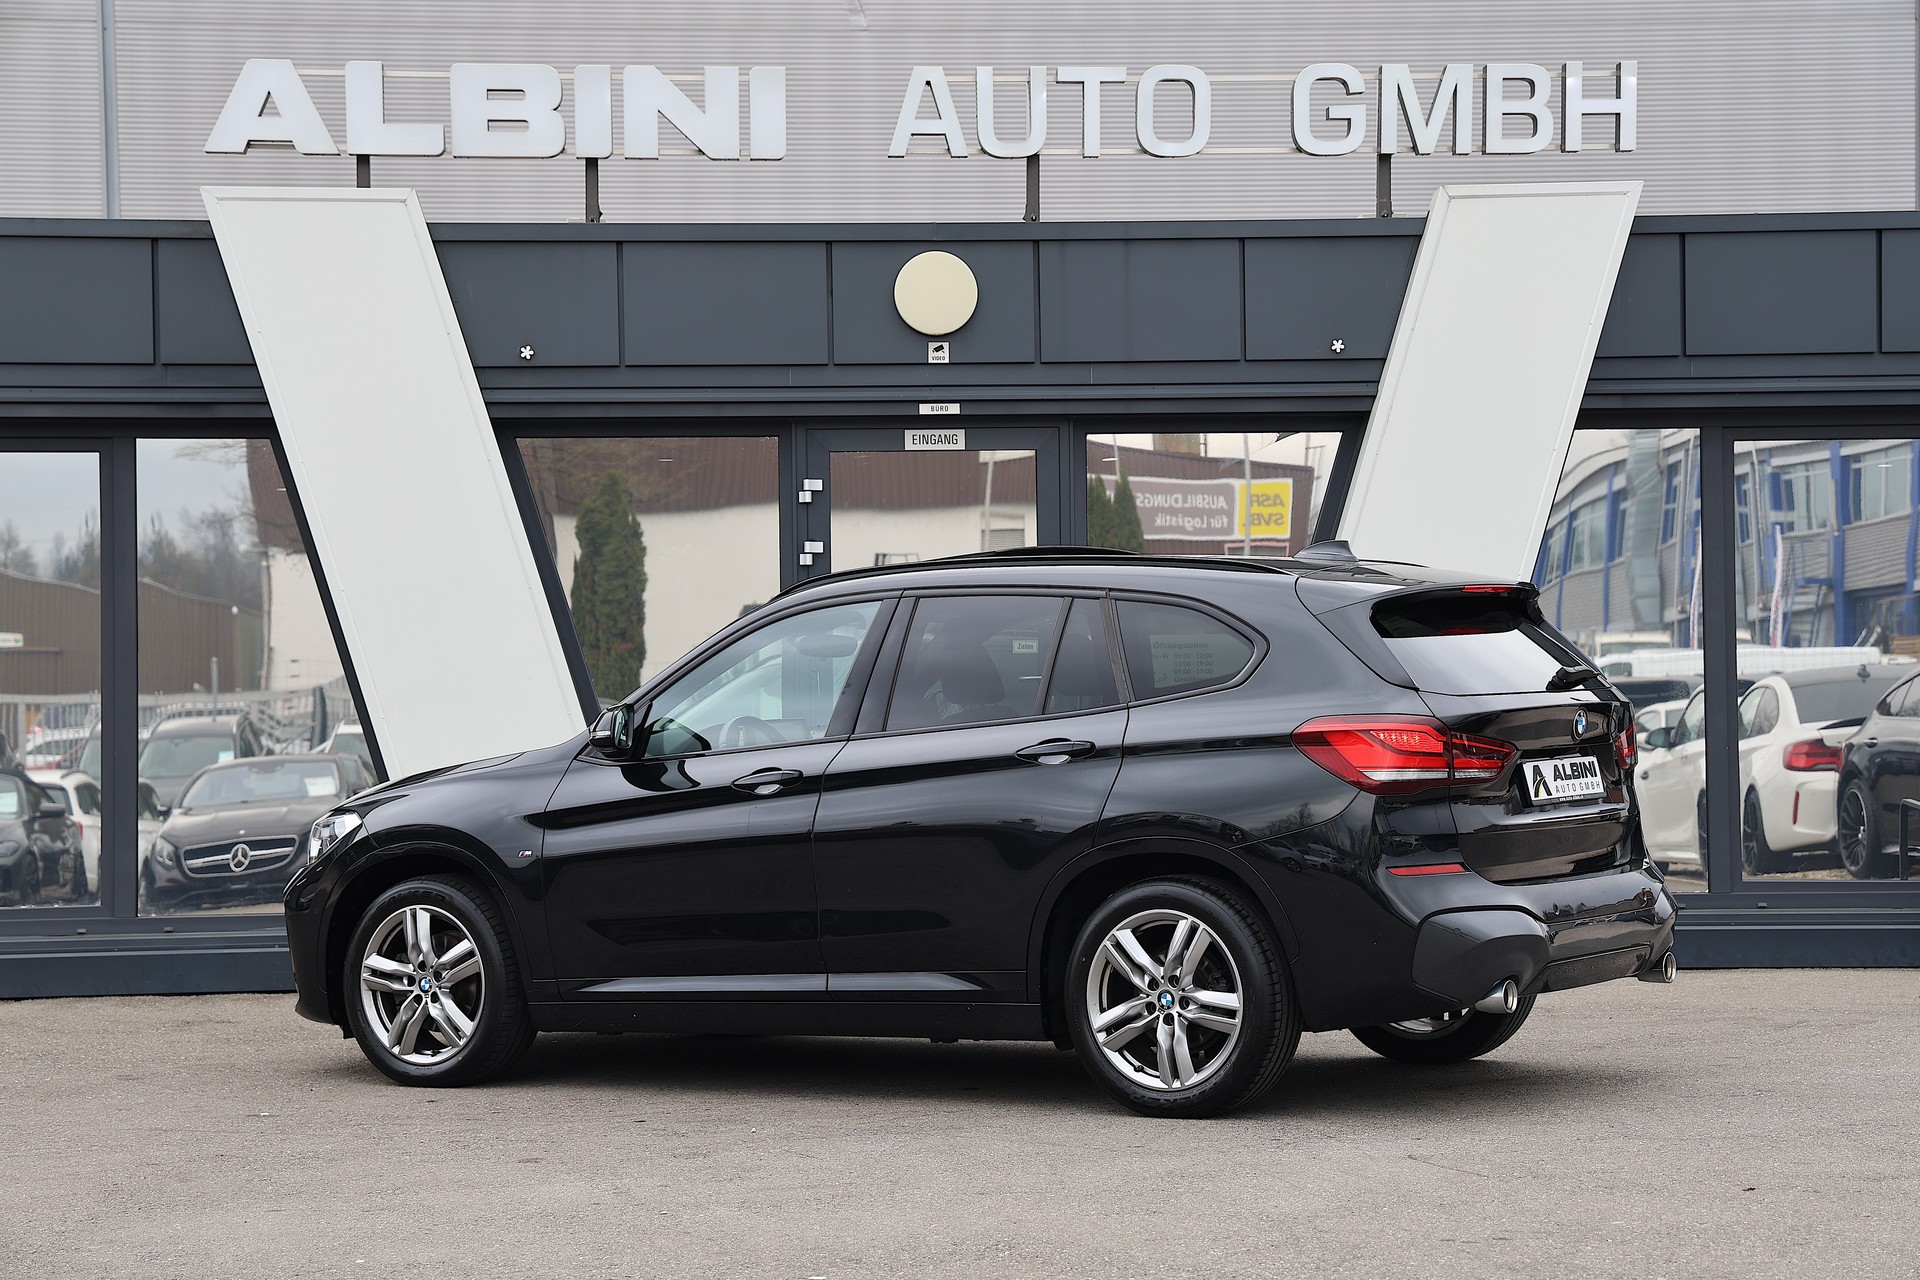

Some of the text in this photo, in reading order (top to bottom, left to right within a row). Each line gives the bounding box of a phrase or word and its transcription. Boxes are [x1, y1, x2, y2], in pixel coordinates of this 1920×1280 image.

[204, 58, 1638, 160] ALBINI AUTO GMBH
[930, 404, 949, 412] BÜRO
[912, 434, 958, 445] EINGANG
[1553, 761, 1598, 782] ALBINI
[1555, 782, 1601, 794] AUTO GMBH
